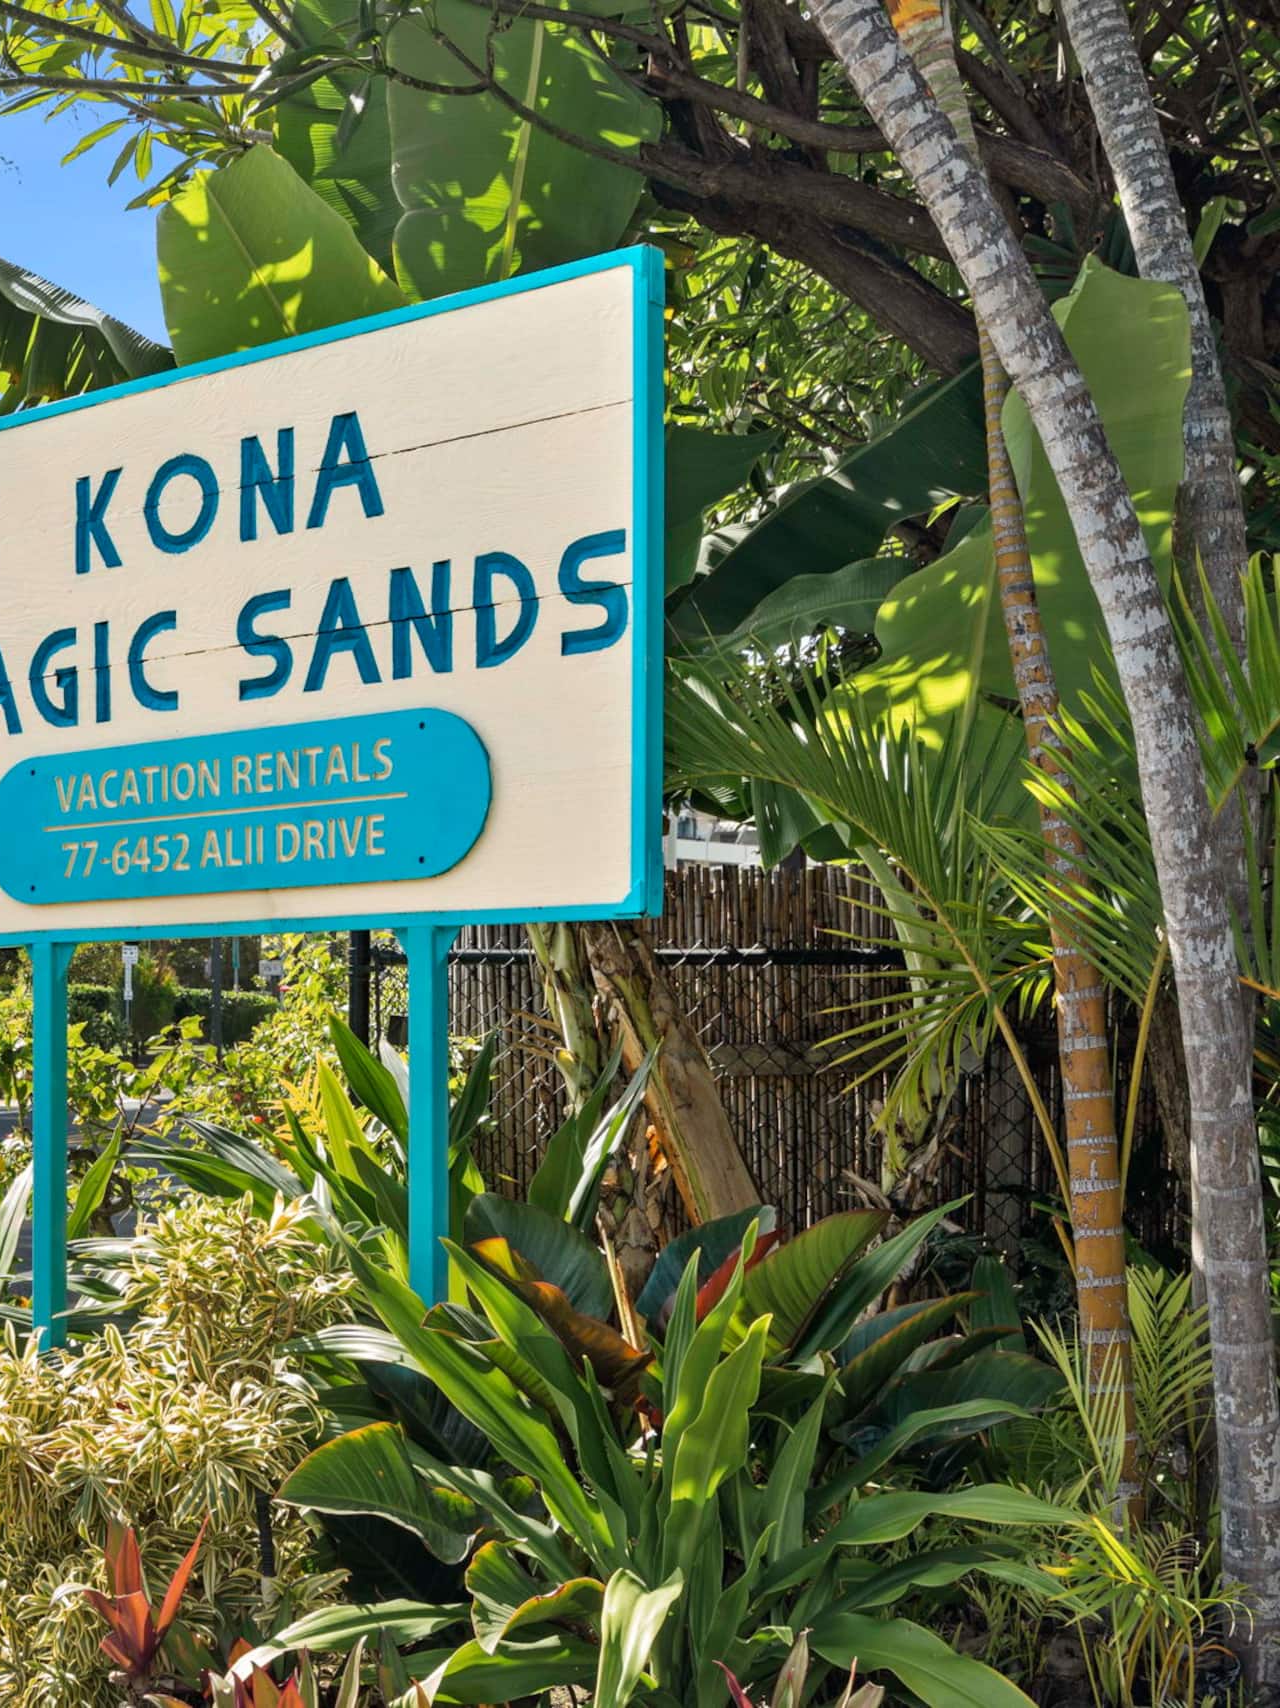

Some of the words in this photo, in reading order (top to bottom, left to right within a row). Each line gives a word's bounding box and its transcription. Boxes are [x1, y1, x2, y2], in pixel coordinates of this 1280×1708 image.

[75, 410, 385, 575] KONA
[236, 528, 629, 701] SANDS
[55, 759, 220, 813] VACATION
[231, 738, 394, 795] RENTALS
[61, 833, 191, 879] 77-6452
[199, 825, 265, 869] ALII
[275, 814, 387, 863] DRIVE
